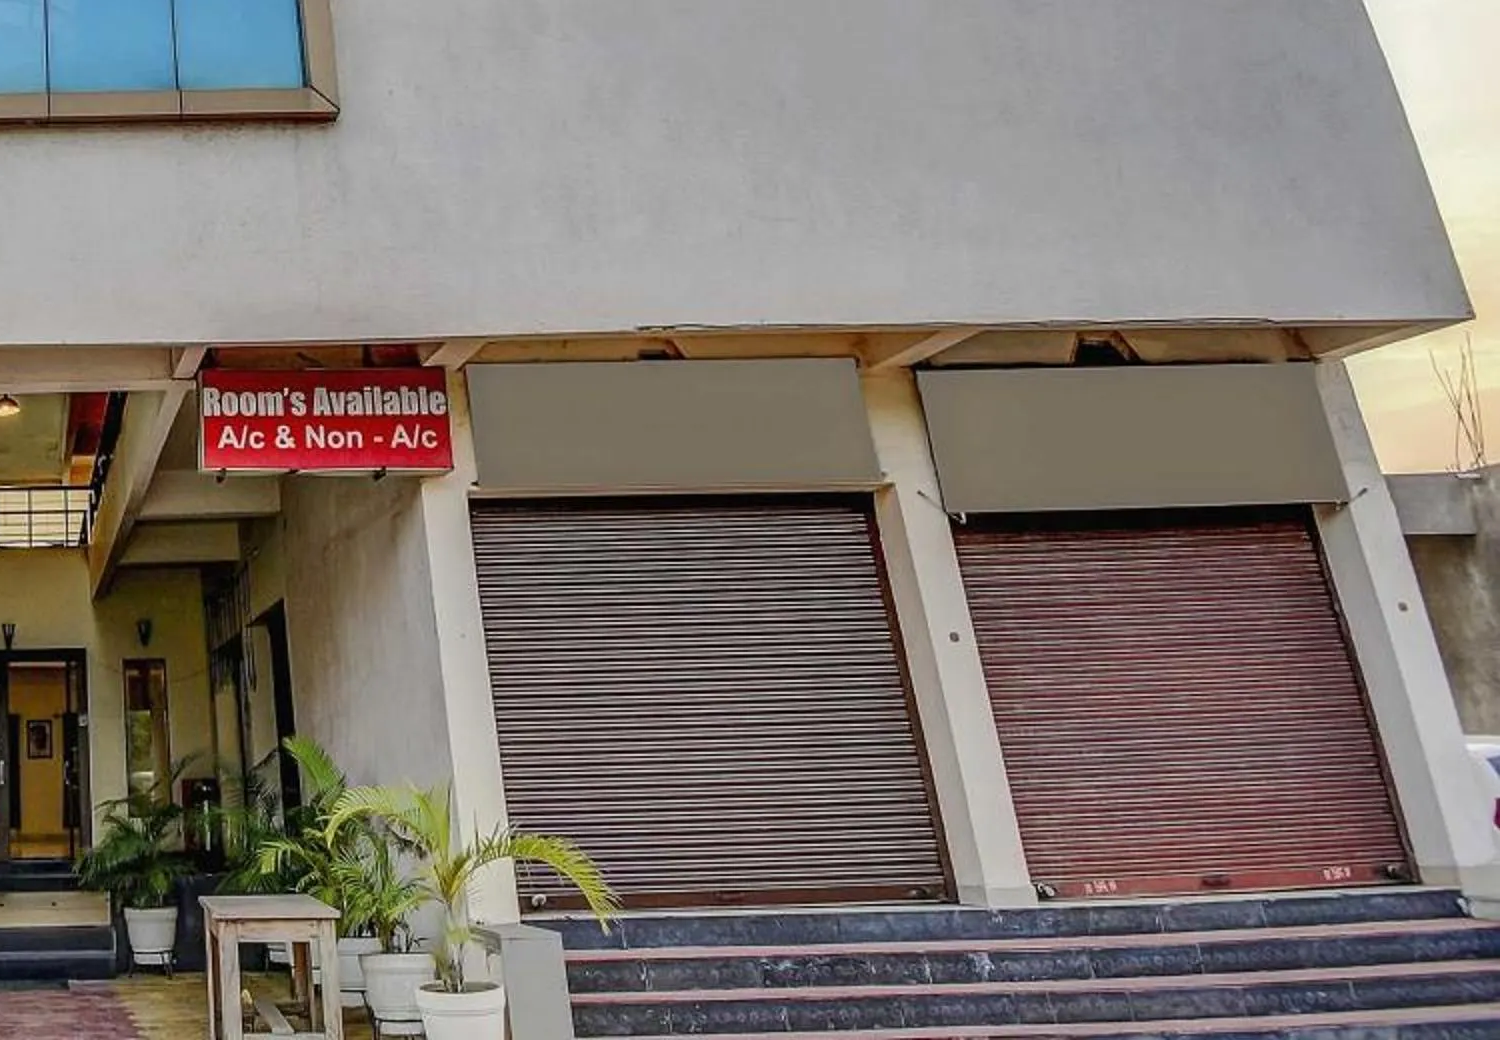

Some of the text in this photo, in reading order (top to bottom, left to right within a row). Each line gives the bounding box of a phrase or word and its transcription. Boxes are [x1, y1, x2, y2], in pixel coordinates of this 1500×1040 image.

[203, 387, 447, 417] Room's Available
[217, 425, 266, 449] A/c
[274, 425, 296, 449] &
[306, 424, 363, 448] Non
[390, 423, 438, 447] A/c
